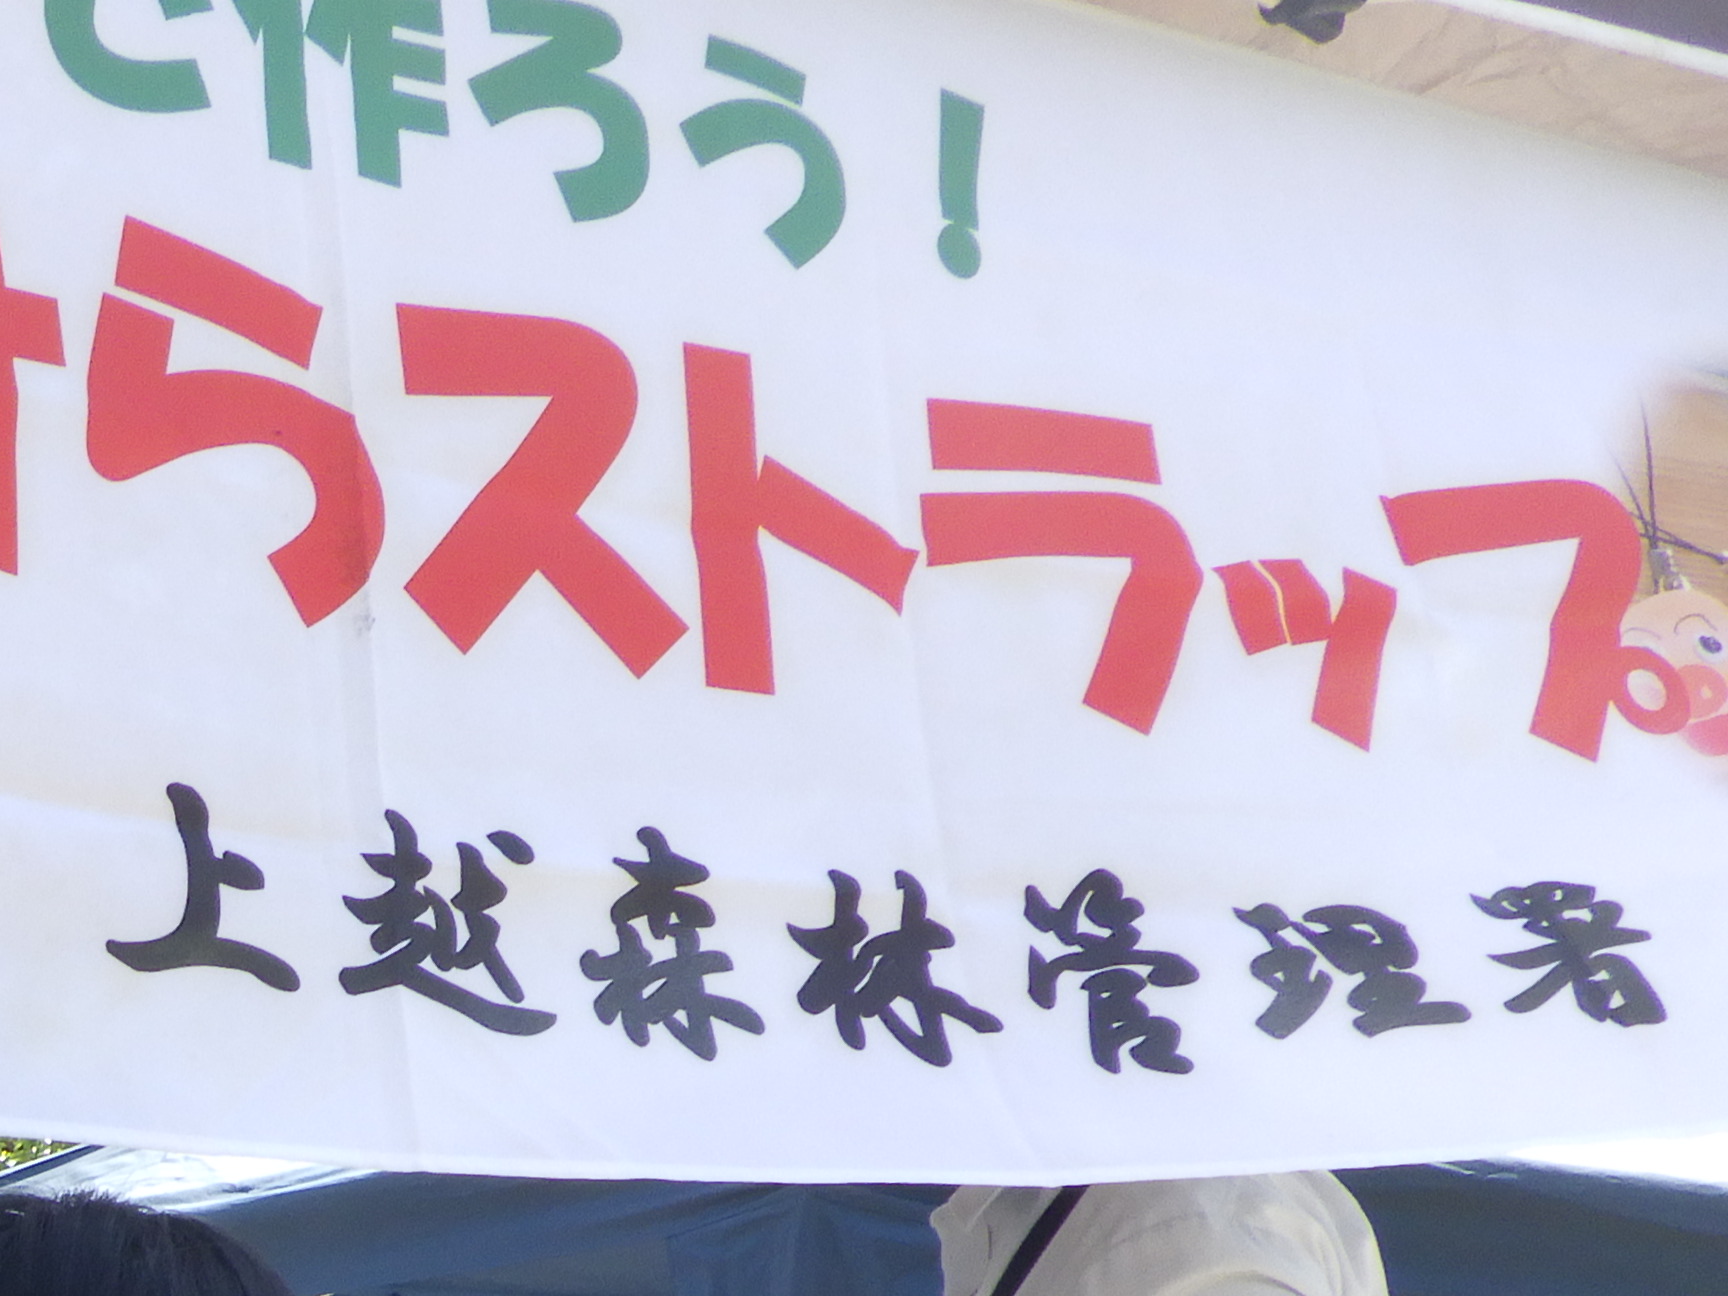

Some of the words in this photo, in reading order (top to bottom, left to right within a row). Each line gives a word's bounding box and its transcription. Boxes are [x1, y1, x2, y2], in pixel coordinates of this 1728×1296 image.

[104, 783, 1666, 1078] 上越森林管理署
